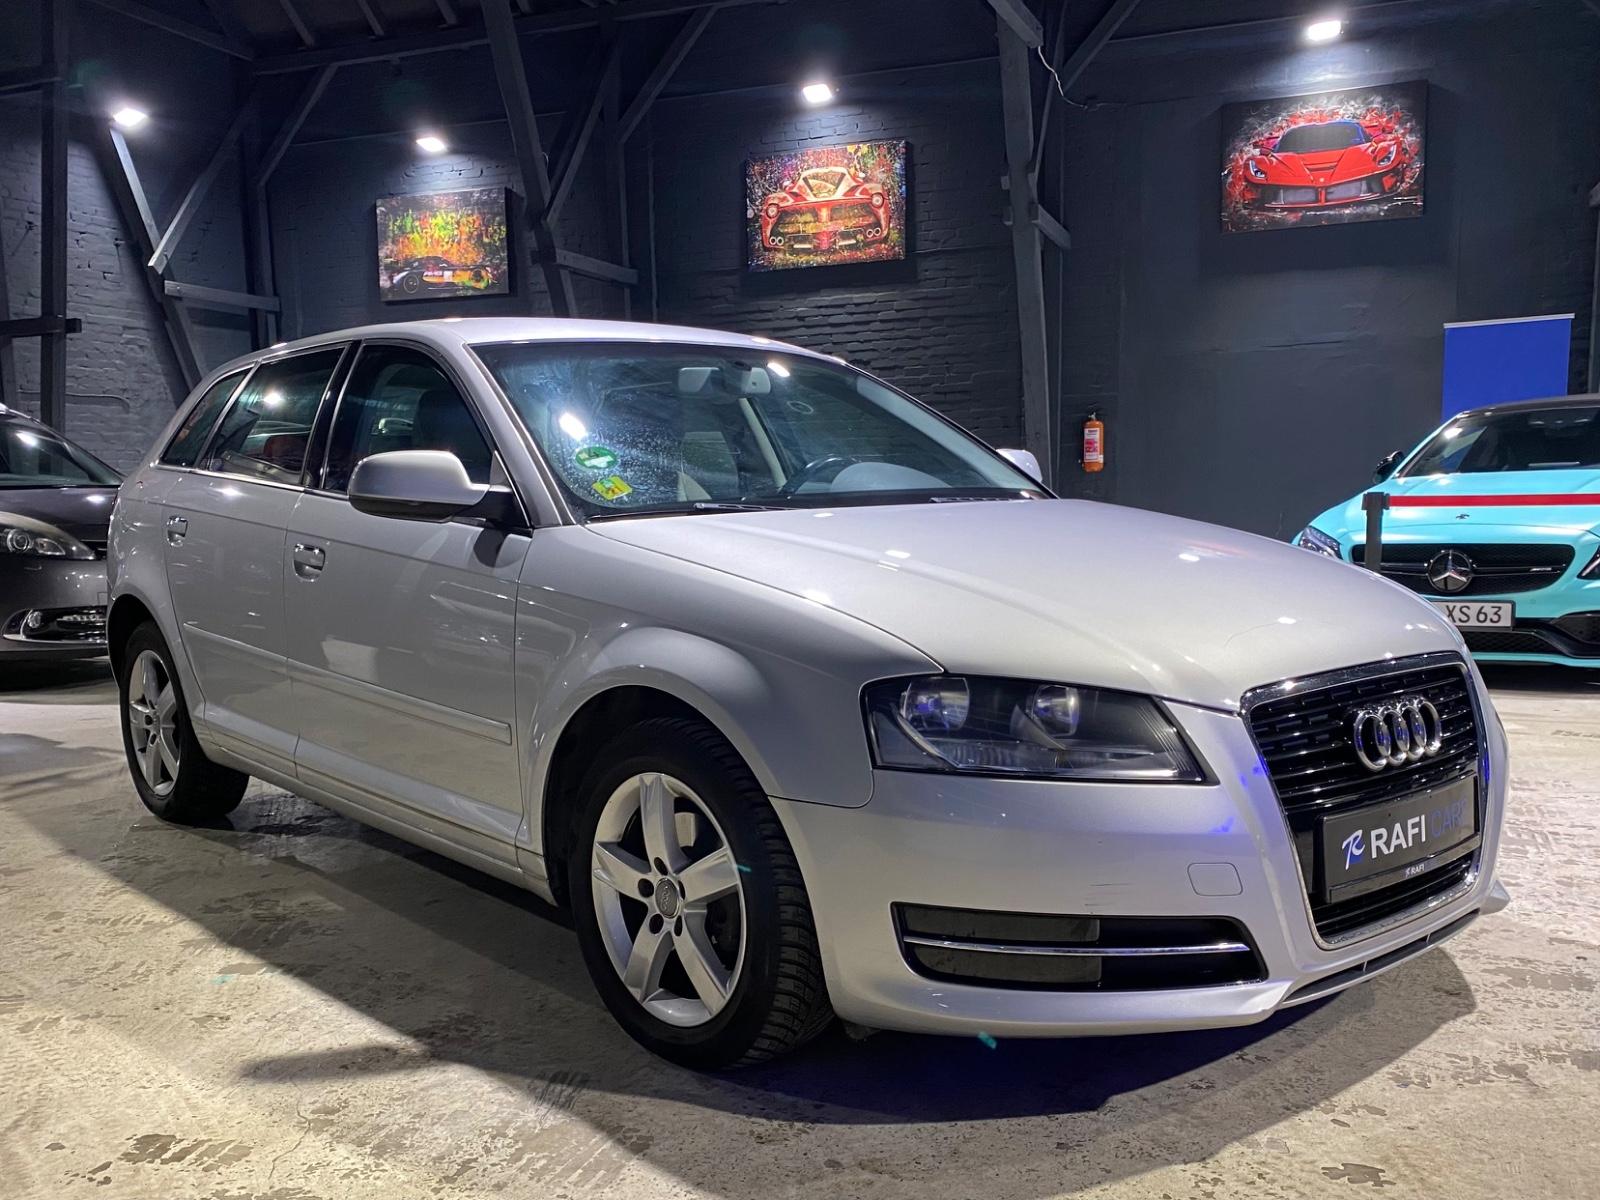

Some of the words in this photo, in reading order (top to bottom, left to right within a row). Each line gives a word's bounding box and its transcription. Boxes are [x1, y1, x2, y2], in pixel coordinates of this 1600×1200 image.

[1445, 605, 1470, 624] XS
[1476, 605, 1503, 624] 63
[1370, 814, 1426, 859] RAFI
